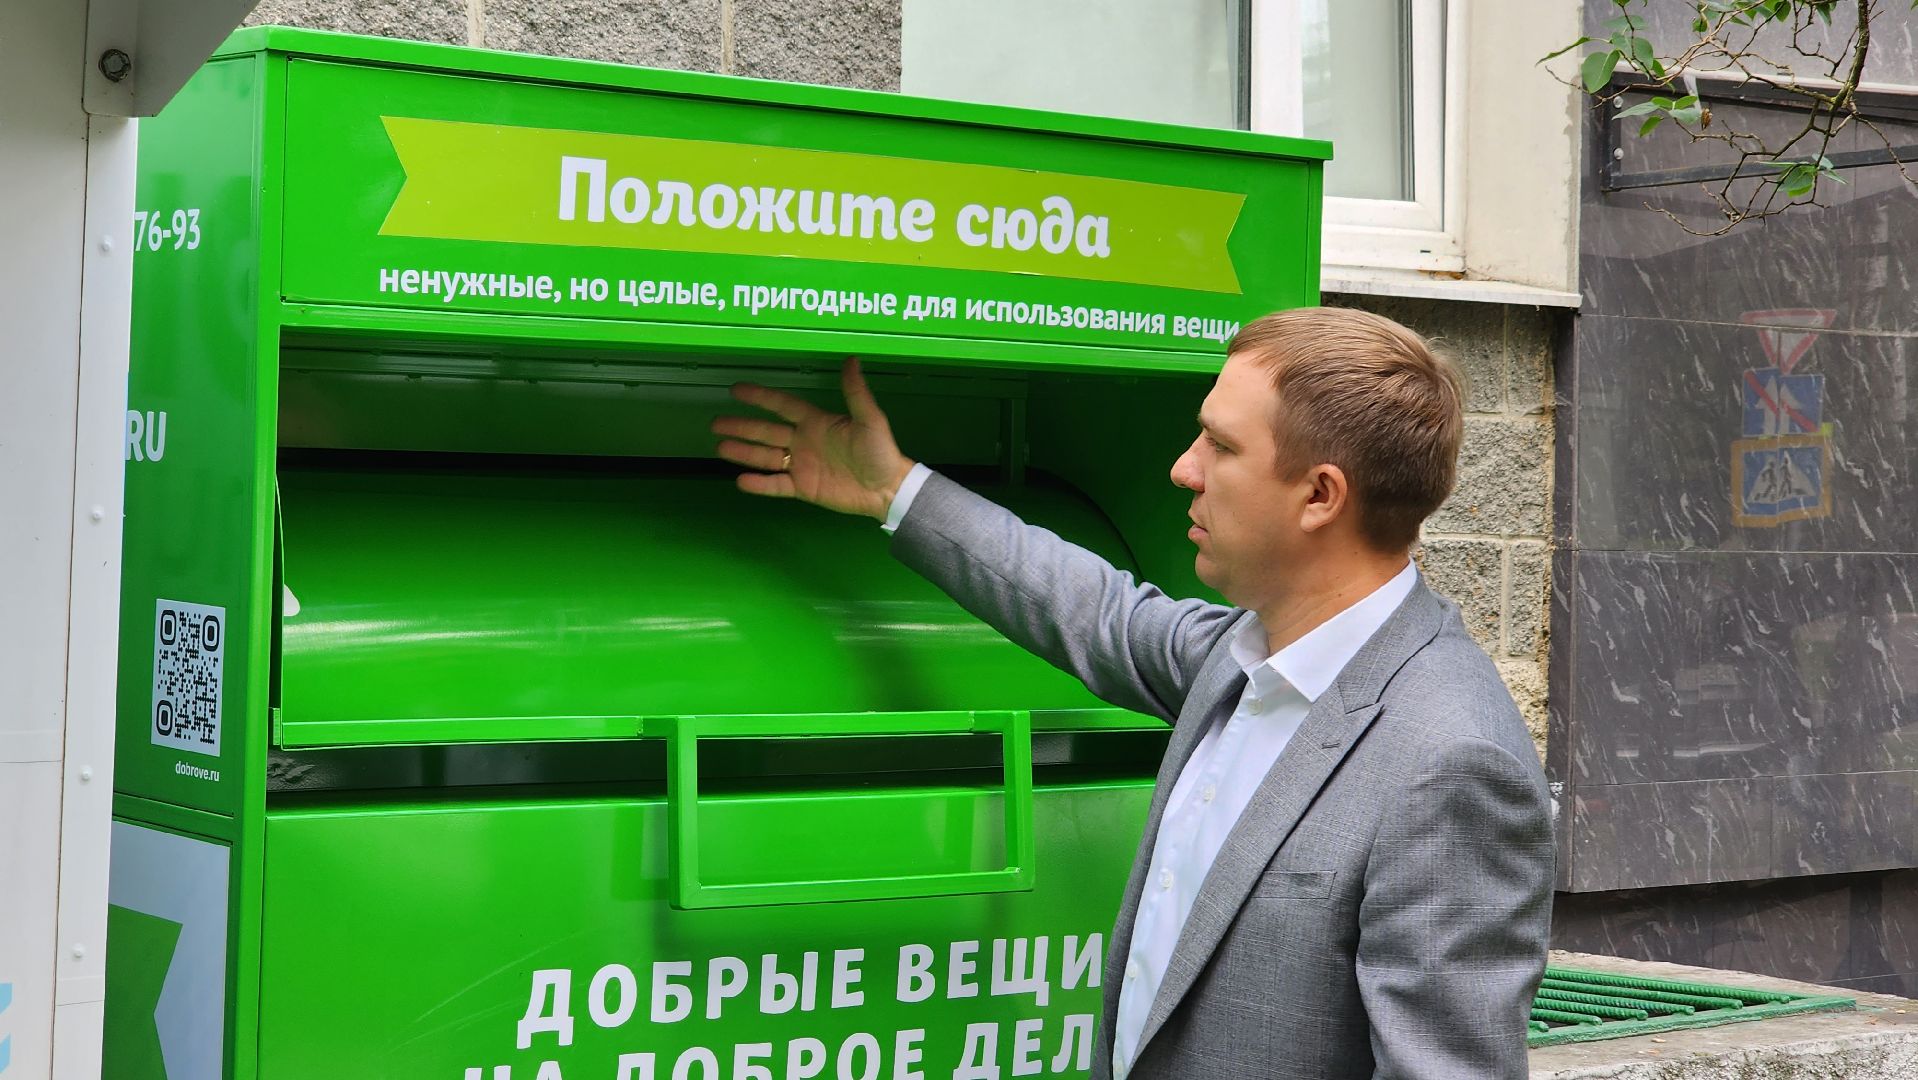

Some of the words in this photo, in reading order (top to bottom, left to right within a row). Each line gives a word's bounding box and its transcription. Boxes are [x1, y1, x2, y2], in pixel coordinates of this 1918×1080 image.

[134, 208, 200, 251] 76-93
[558, 155, 937, 243] Положите
[956, 195, 1111, 258] сюда
[379, 268, 562, 304] ненужные,
[569, 277, 609, 301] но
[618, 279, 726, 311] целые,
[733, 284, 898, 317] пригодные
[902, 294, 957, 322] для
[965, 298, 1166, 335] использования
[1172, 315, 1240, 344] вещи
[175, 760, 220, 782] dobrove.ru
[516, 948, 865, 1050] ДОБРЫЕ
[896, 932, 1103, 1007] ВЕЩИ
